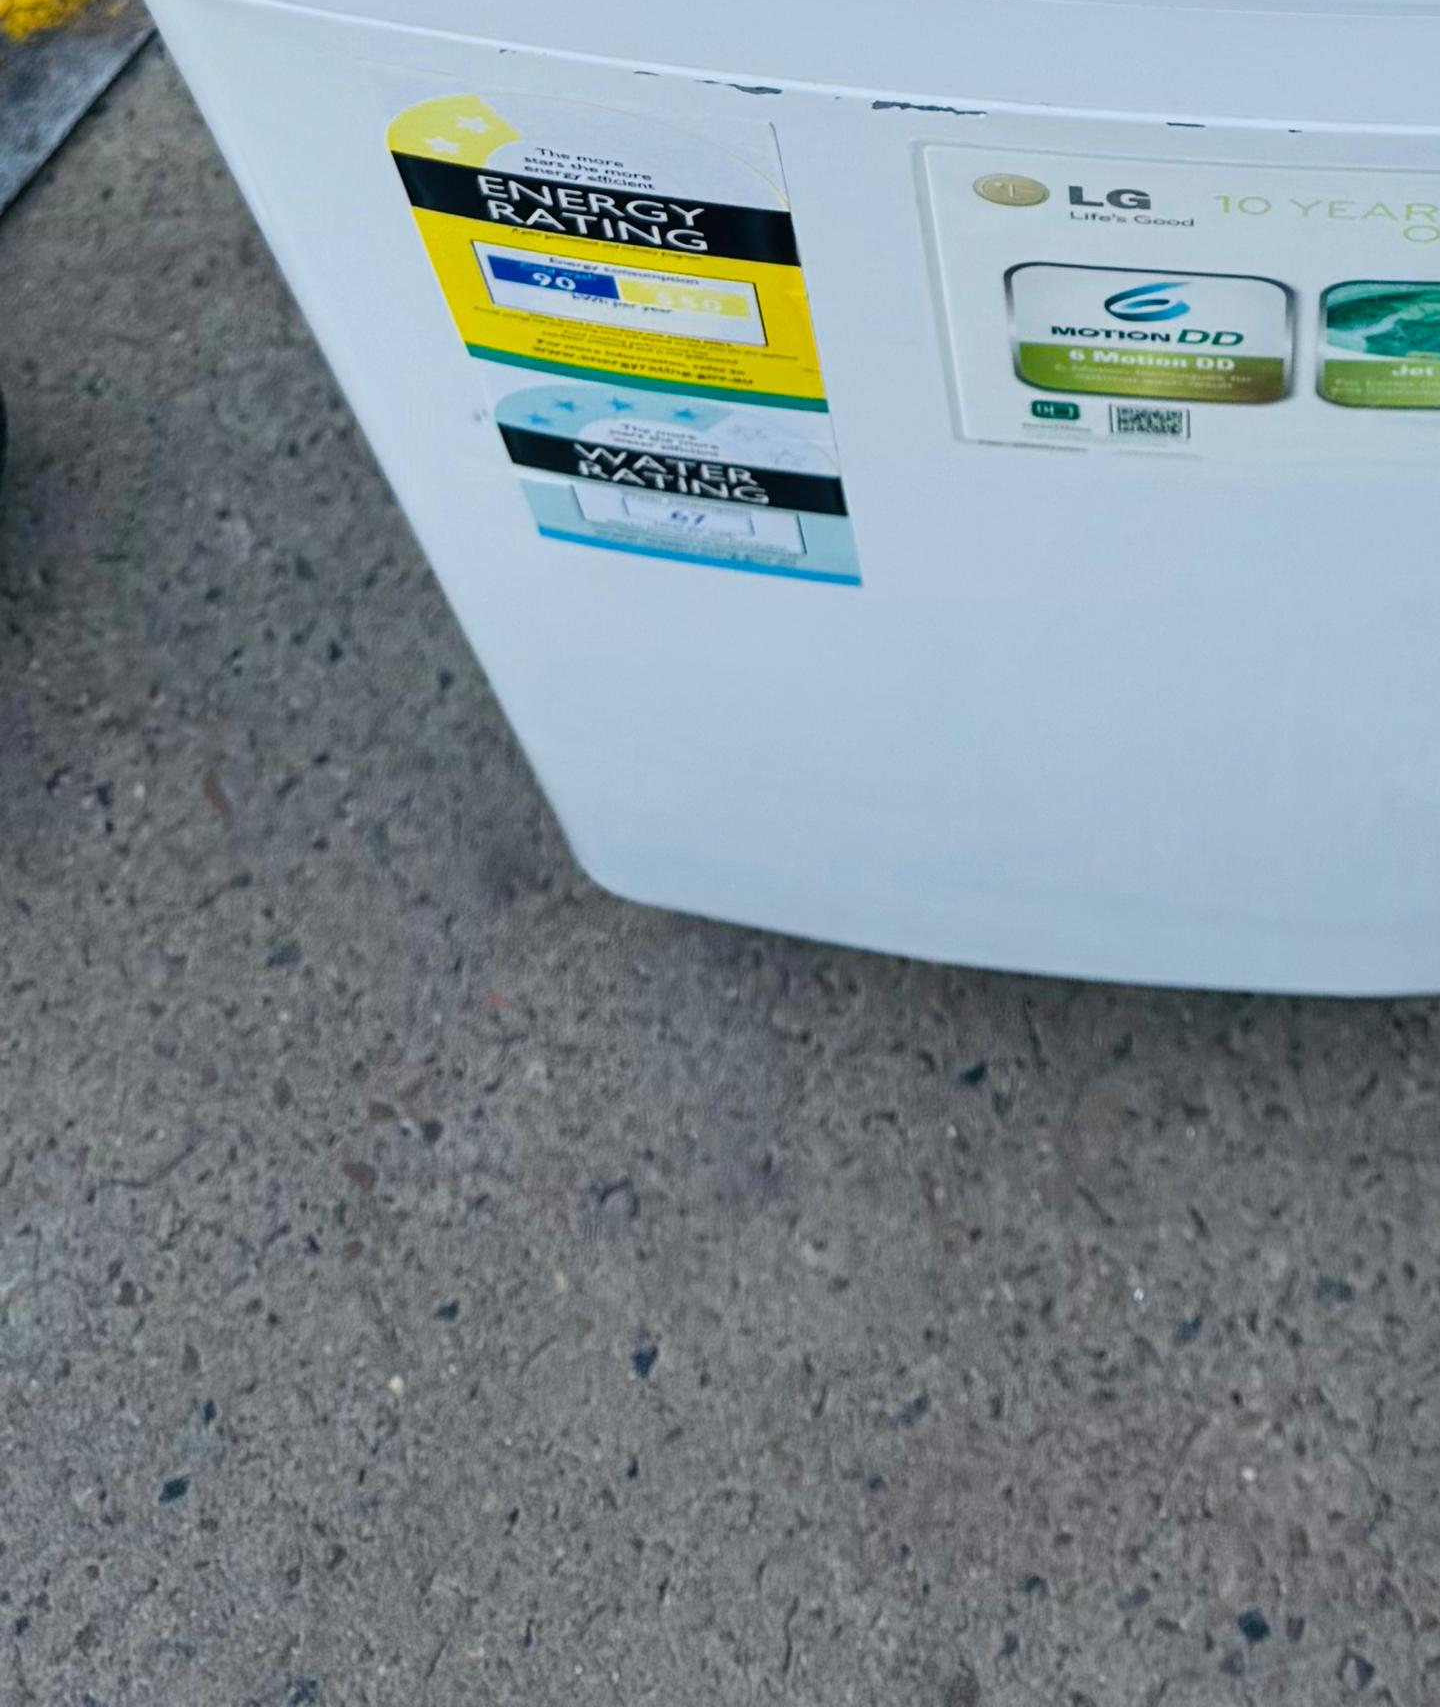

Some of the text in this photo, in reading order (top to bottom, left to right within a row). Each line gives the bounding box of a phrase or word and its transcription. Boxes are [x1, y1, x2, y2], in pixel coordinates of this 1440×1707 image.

[524, 156, 652, 180] stars the more
[536, 147, 624, 168] The more
[524, 165, 581, 181] energy
[476, 174, 705, 227] ENERGY
[1069, 186, 1151, 210] LG
[1214, 195, 1271, 216] 10
[1290, 199, 1438, 222] YEAR
[486, 200, 709, 252] RATING
[1070, 210, 1194, 228] Life's Good
[532, 272, 576, 291] 90
[1051, 326, 1244, 347] MOTION DD
[1093, 350, 1187, 369] Motion
[1196, 357, 1235, 371] DD
[574, 443, 759, 486] WATER
[579, 460, 769, 504] RATING
